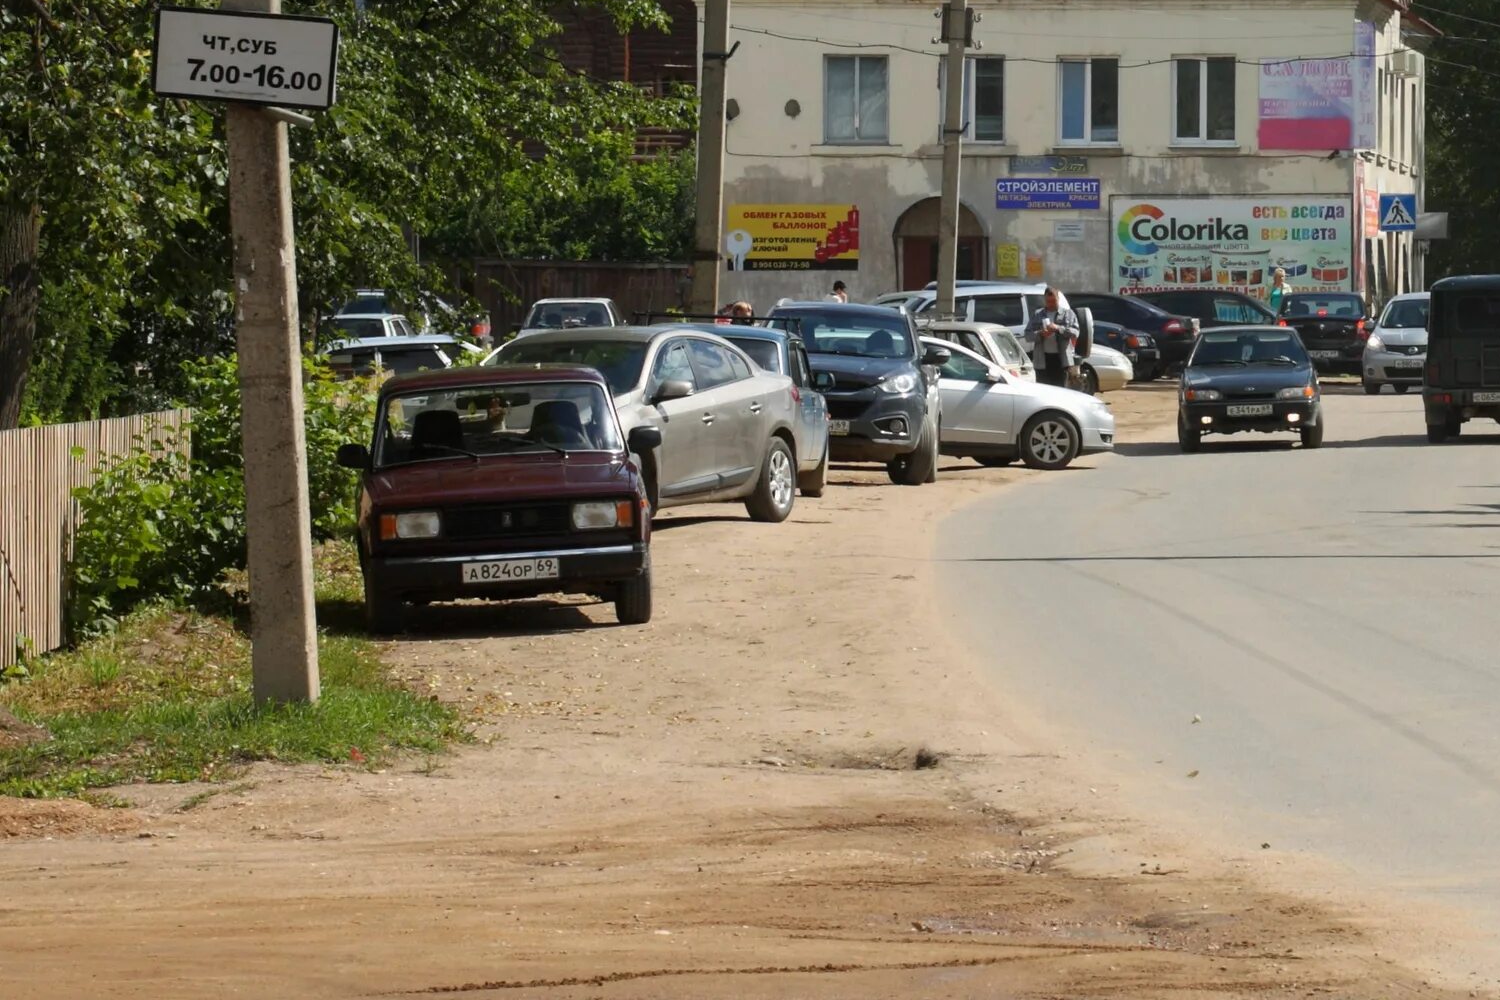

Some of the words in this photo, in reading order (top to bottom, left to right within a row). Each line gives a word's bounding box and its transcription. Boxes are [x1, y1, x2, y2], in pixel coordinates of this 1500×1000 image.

[203, 35, 277, 56] ЧТ,СУБ
[187, 58, 322, 92] 7.00-16.00
[996, 180, 1099, 192] СТРОЙЭЛЕМЕНТ
[743, 211, 777, 219] ОБМЕН
[780, 211, 827, 219] ГАЗОВЫХ
[1252, 205, 1287, 219] есть
[1291, 205, 1345, 220] всегда
[772, 222, 827, 230] БАЛЛОНОВ
[1131, 217, 1249, 241] Colorika
[1261, 227, 1288, 240] все
[1291, 227, 1337, 241] цвета
[752, 244, 788, 252] КЛЮЧЕЙ
[469, 563, 532, 581] А824ОР
[537, 560, 553, 572] 69
